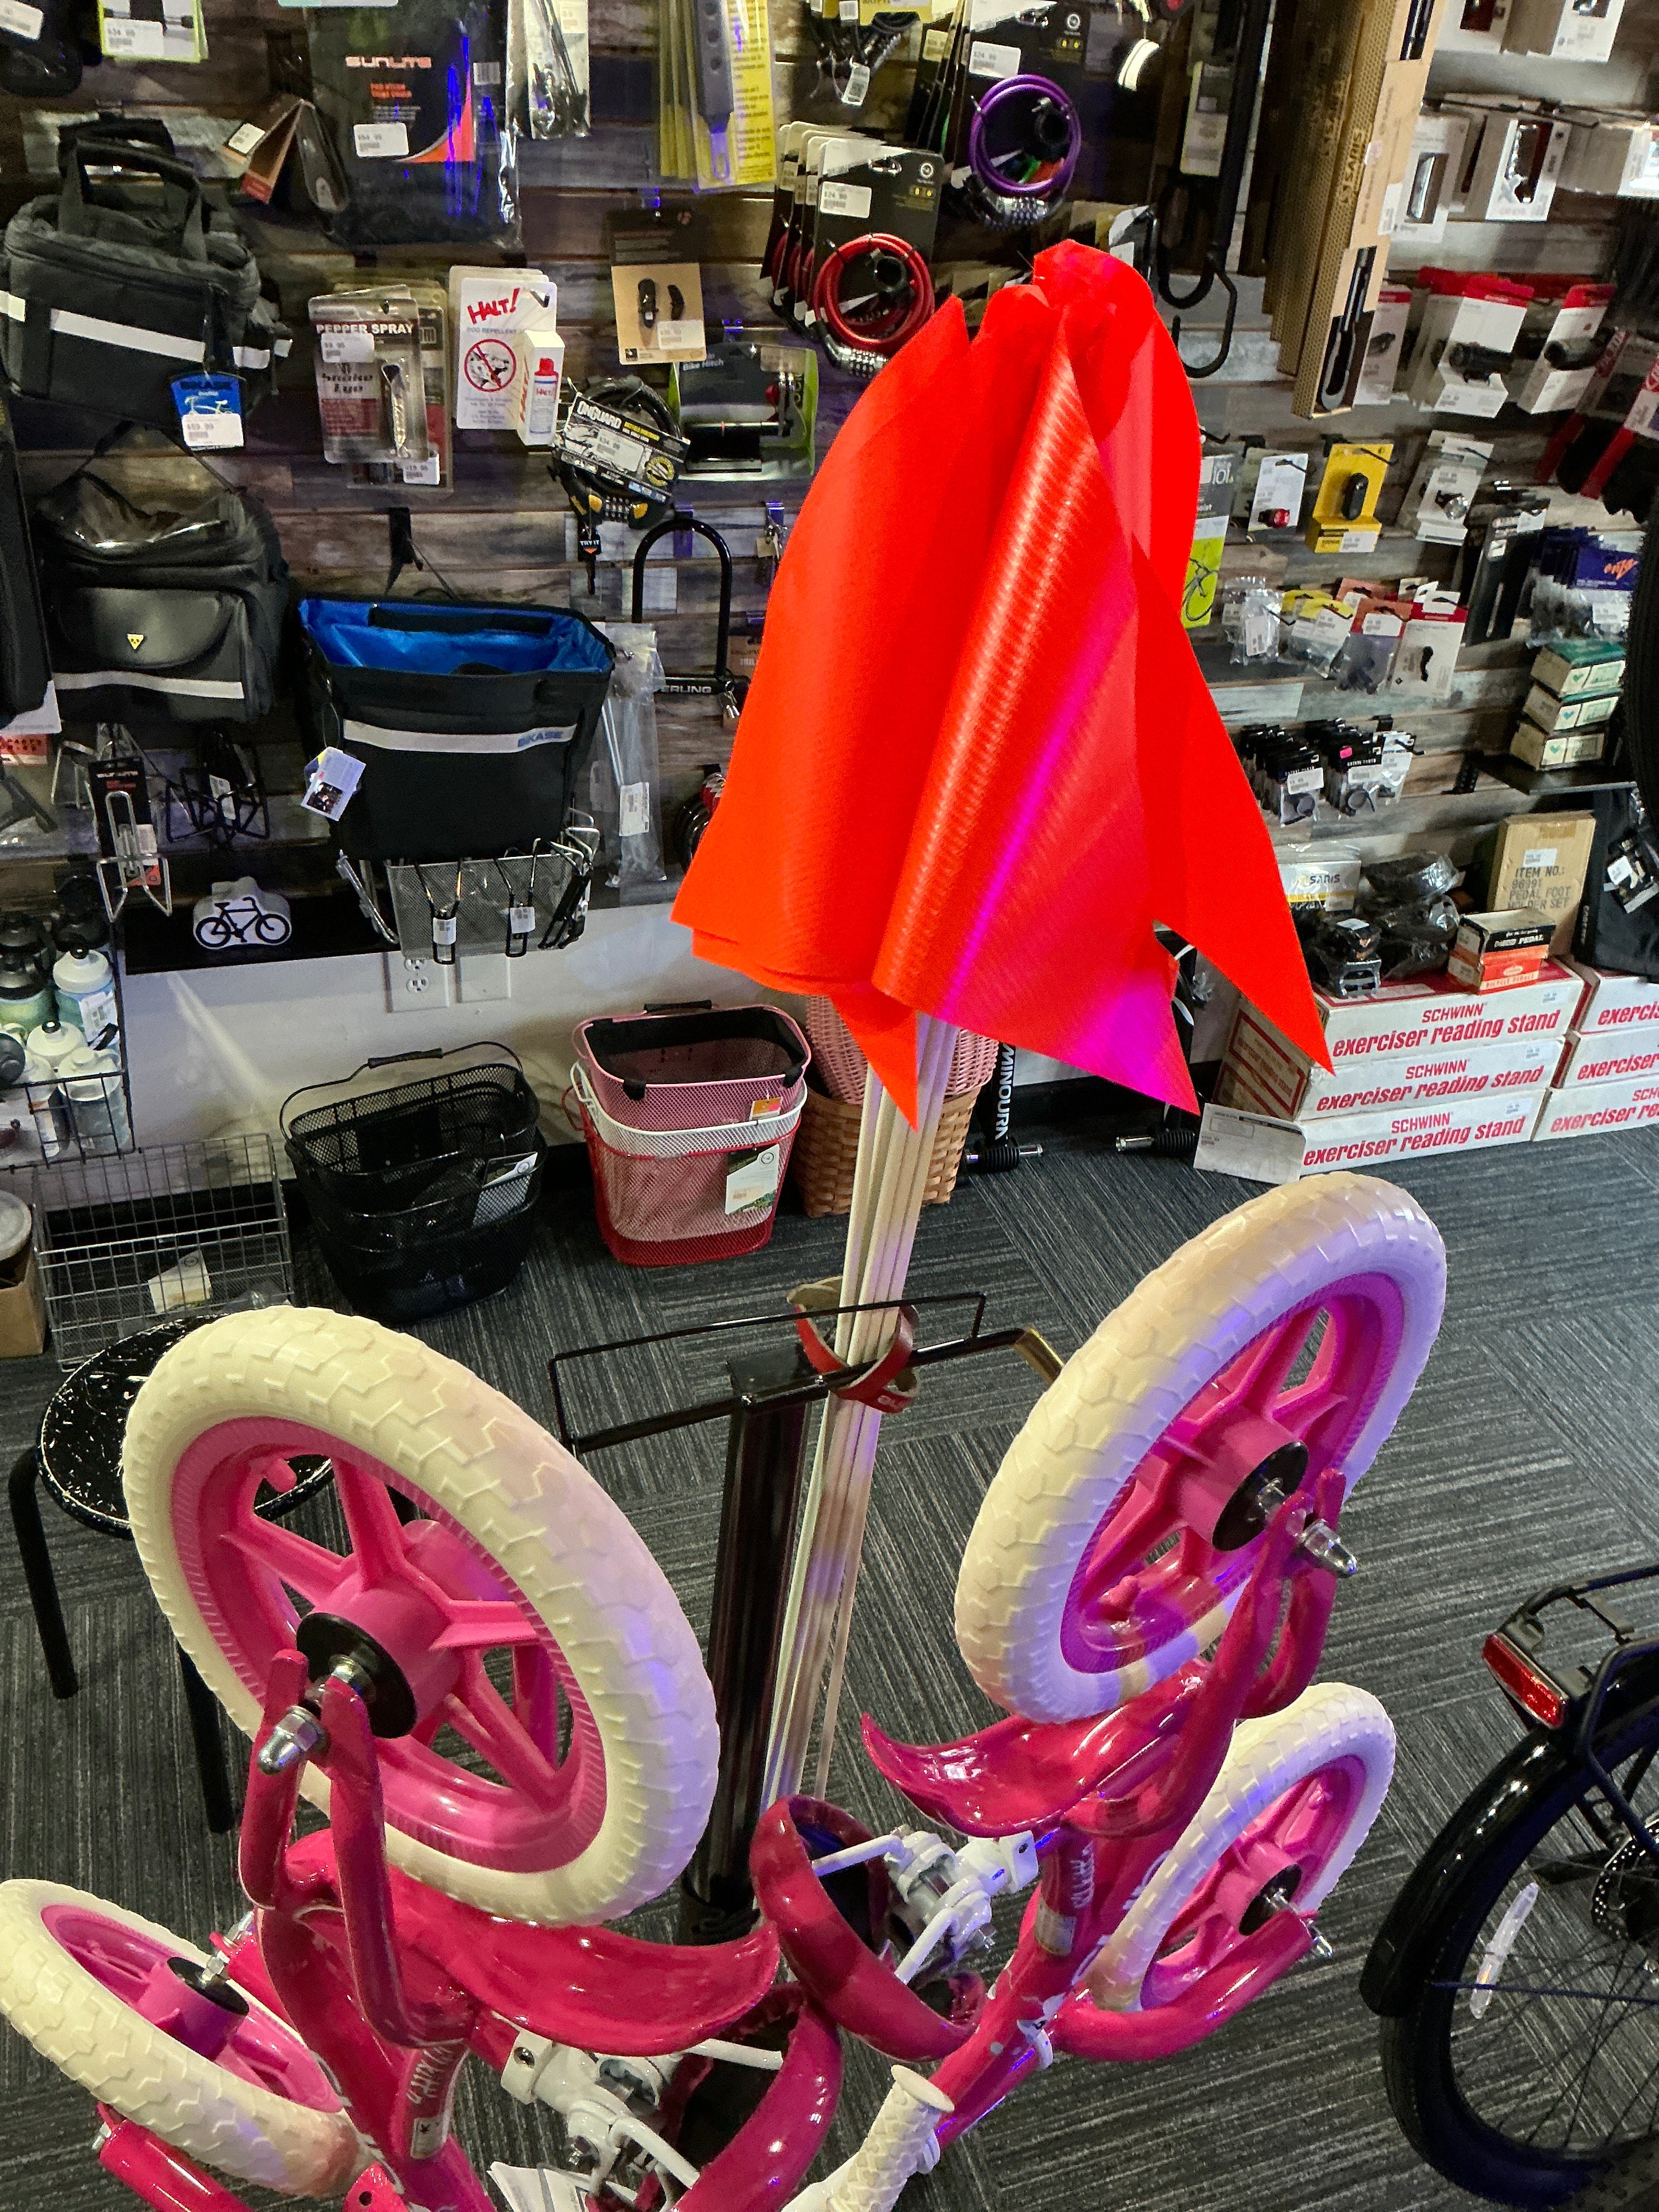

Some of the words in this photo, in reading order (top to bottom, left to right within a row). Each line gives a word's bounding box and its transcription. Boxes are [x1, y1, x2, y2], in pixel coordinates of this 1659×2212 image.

[467, 287, 520, 324] HALT!
[316, 324, 368, 334] PEPPER
[371, 323, 413, 335] SPRAY
[661, 685, 712, 693] ERLING
[1310, 874, 1340, 883] SARIS
[1515, 867, 1541, 878] ITEM
[1509, 889, 1541, 901] PEDAL
[1545, 886, 1572, 898] FOOT
[1550, 898, 1570, 909] SET
[1421, 1003, 1483, 1023] SCHWINN
[1333, 1028, 1428, 1058] exerciser
[1430, 1016, 1504, 1045] reading
[1507, 1009, 1561, 1034] stand
[1405, 1060, 1468, 1080] SCHWINN
[1577, 1053, 1659, 1080] exerciser
[995, 1043, 1014, 1140] MINOURA
[1316, 1087, 1412, 1111] exerciser
[1414, 1075, 1489, 1099] reading
[1491, 1065, 1544, 1088] stand
[1632, 1087, 1659, 1102] SCH
[1391, 1113, 1451, 1134] SCHWINN
[1550, 1106, 1637, 1133] exerciser
[1304, 1139, 1397, 1166] exerciser
[1400, 1126, 1471, 1151] reading
[1475, 1116, 1527, 1140] stand
